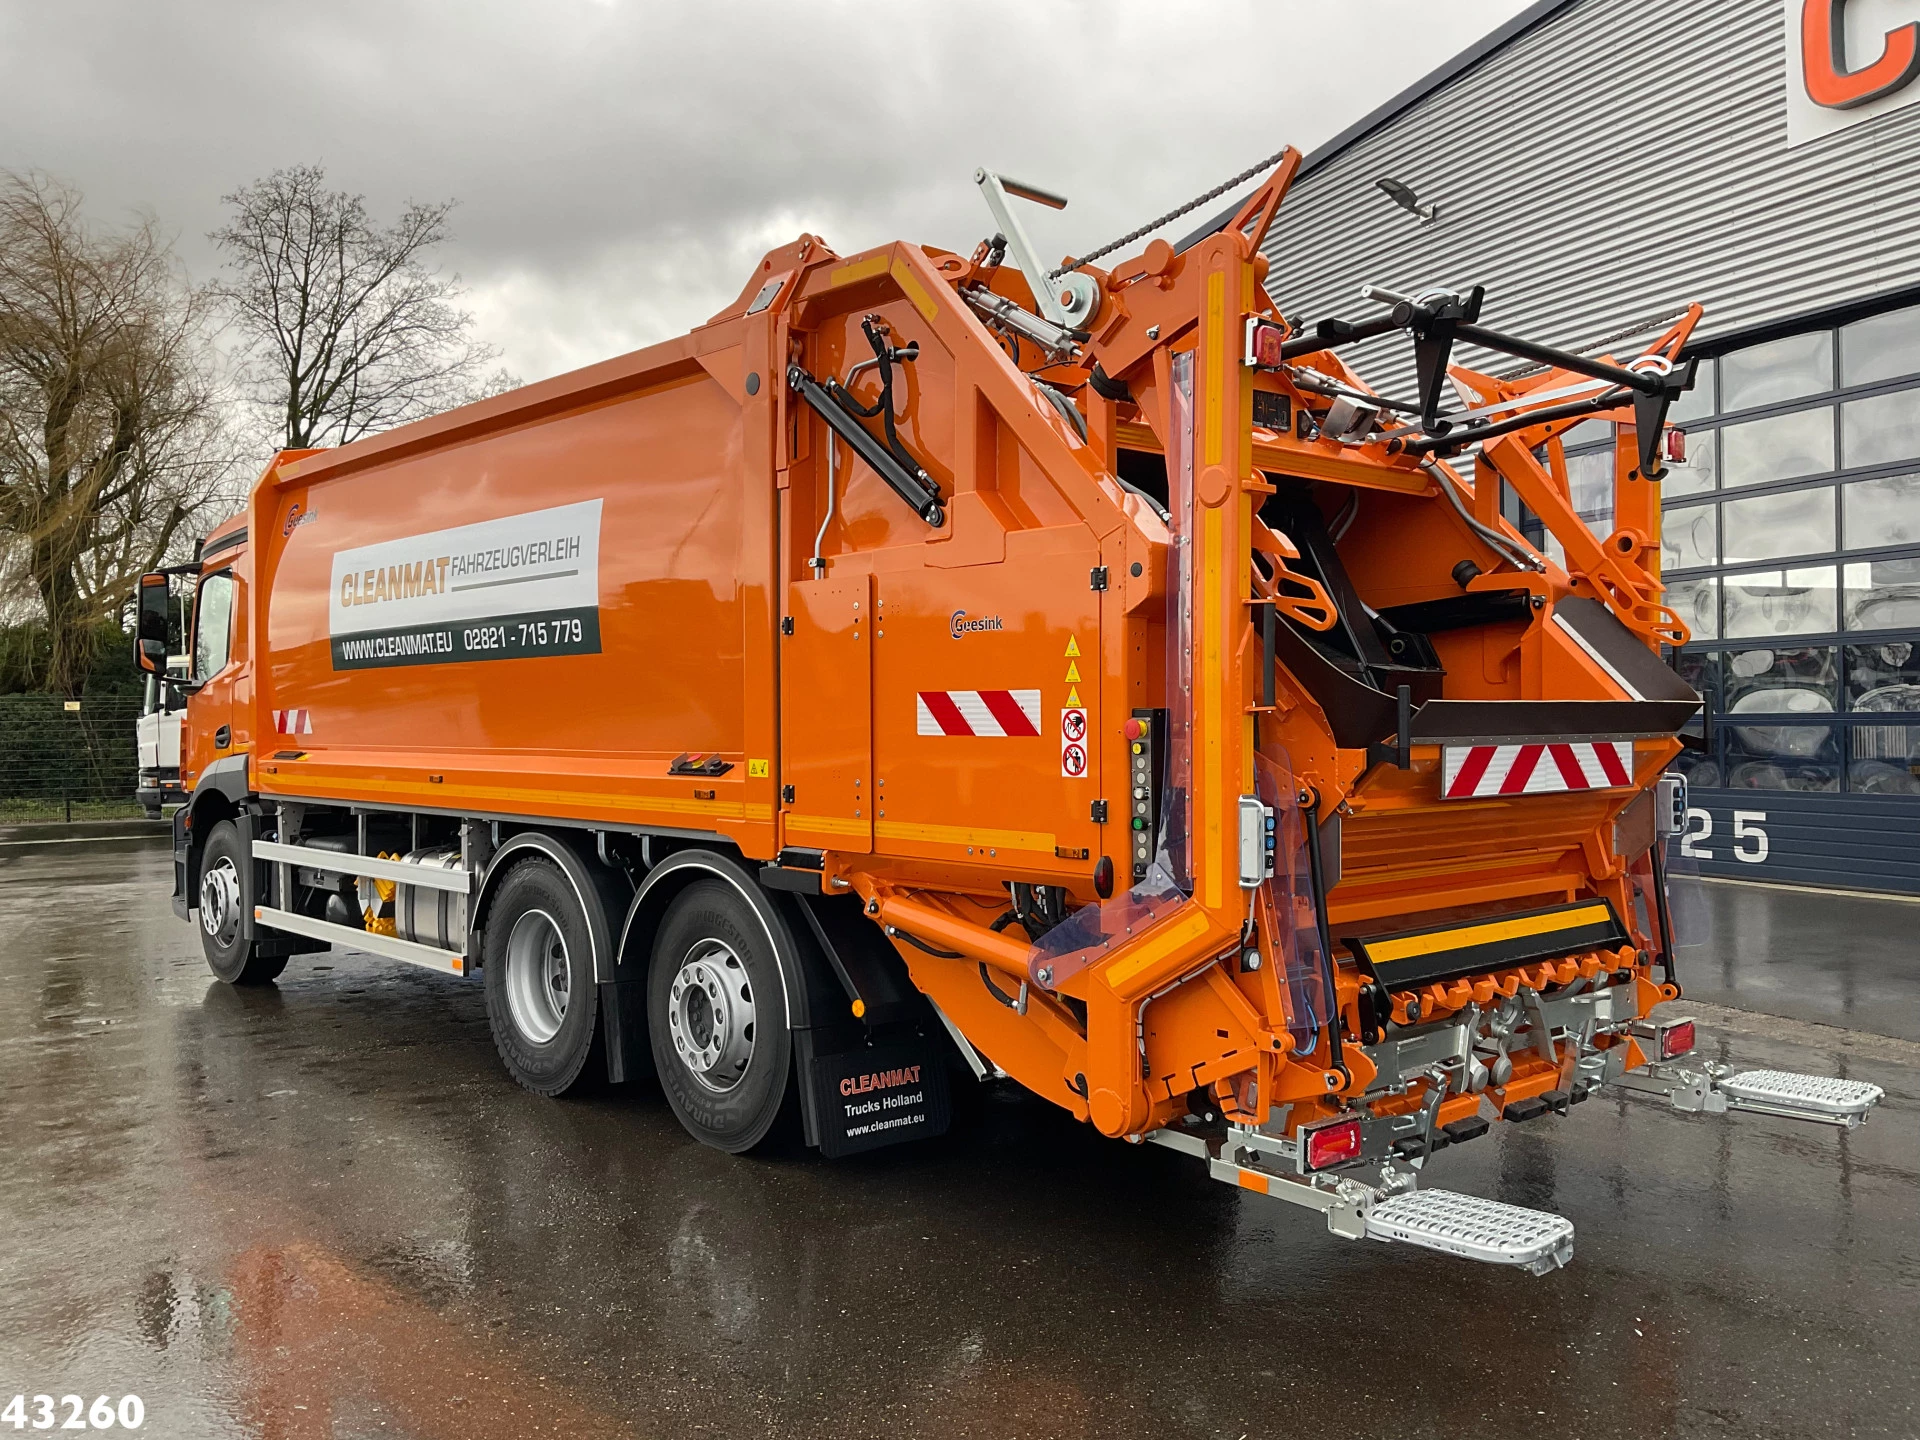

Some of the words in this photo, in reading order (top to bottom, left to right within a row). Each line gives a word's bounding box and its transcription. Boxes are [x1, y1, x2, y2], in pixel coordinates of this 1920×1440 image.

[340, 556, 451, 608] CLEANMAT
[451, 535, 581, 577] FAHRZEUGVERLEIH
[954, 613, 1003, 633] Geesink
[342, 632, 454, 660] WWW.CLEANMAT.EU
[464, 627, 506, 651] 02821
[519, 622, 547, 647] 715
[551, 619, 582, 645] 779
[839, 1066, 921, 1097] CLEANMAT
[845, 1101, 881, 1117] Trucks
[883, 1091, 923, 1110] Holland
[846, 1113, 925, 1137] www.cleanmat.eu
